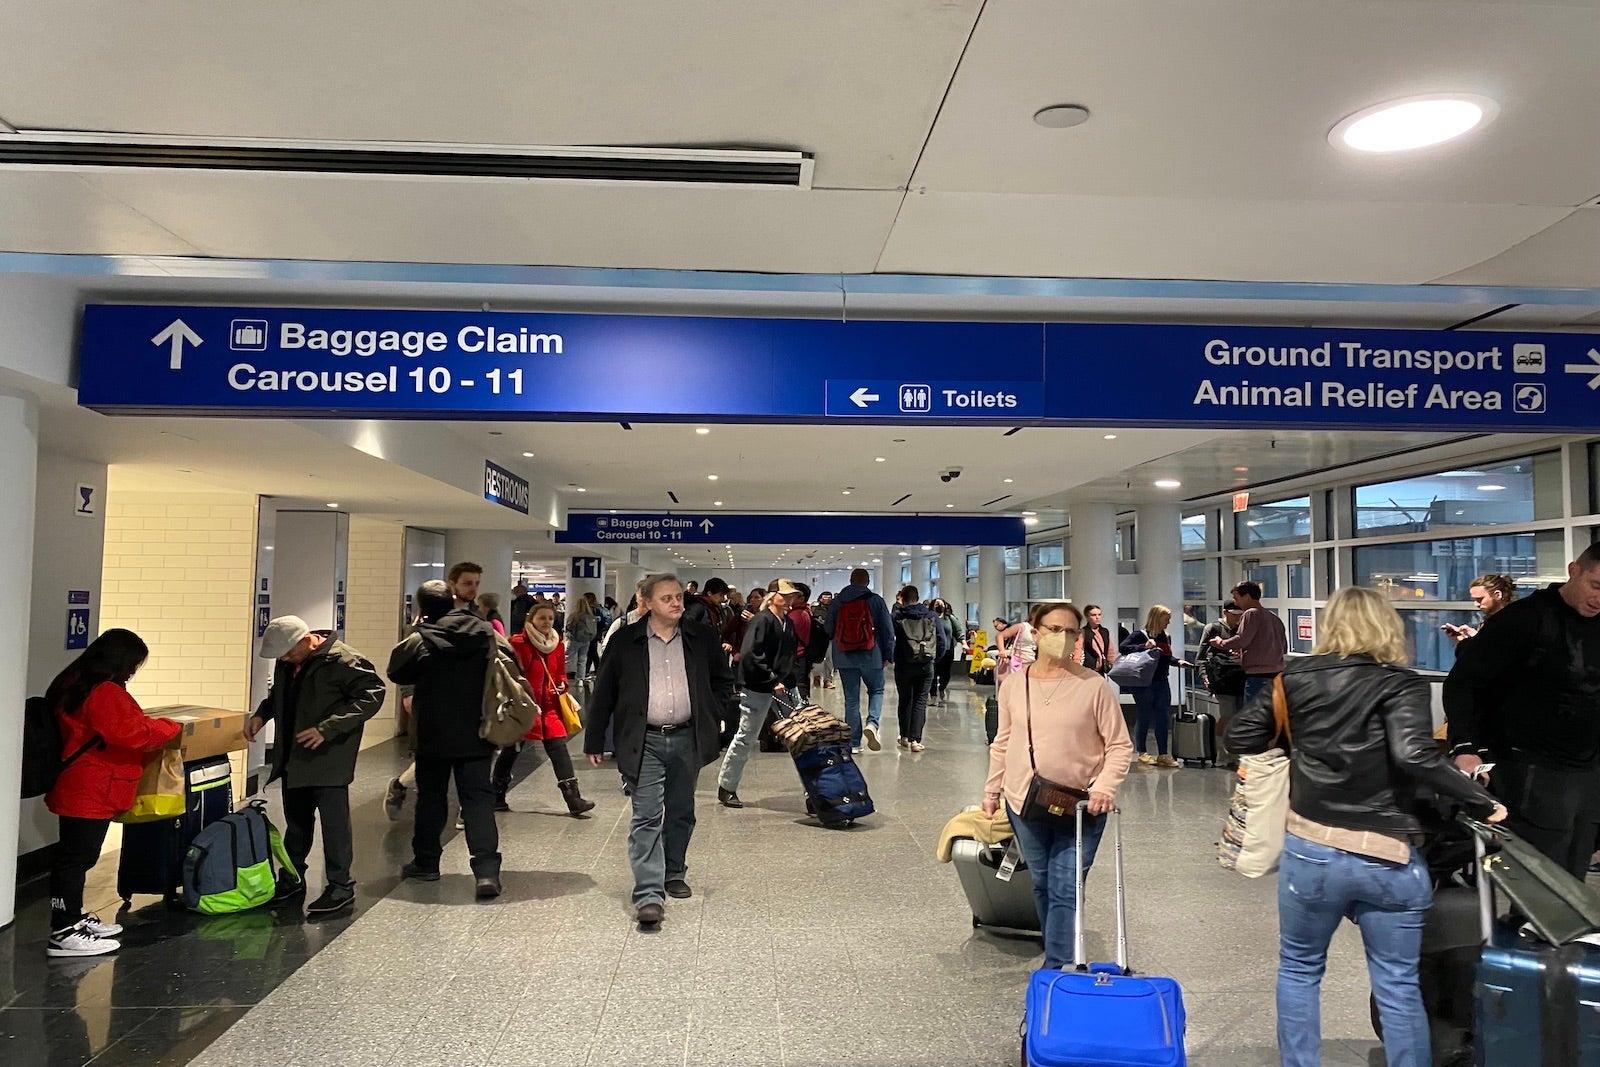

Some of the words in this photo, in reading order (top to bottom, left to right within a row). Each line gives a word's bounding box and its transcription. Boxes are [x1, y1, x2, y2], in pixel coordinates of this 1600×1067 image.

[280, 323, 448, 358] Baggage
[457, 325, 563, 354] Claim
[1204, 339, 1331, 367] Ground
[1339, 342, 1502, 375] Transport
[227, 363, 397, 393] Carousel
[408, 366, 451, 394] 10
[460, 379, 475, 387] -
[485, 368, 523, 395] 11
[1193, 379, 1312, 407] Animal
[1322, 382, 1418, 408] Relief
[1424, 384, 1502, 411] Area
[942, 390, 1017, 408] Toilets
[485, 467, 529, 509] RESTROOMS
[597, 530, 646, 540] Carousel
[648, 530, 661, 540] 10
[670, 531, 682, 540] 11
[611, 518, 660, 529] Baggage
[661, 518, 693, 528] Claim
[575, 558, 599, 578] 11
